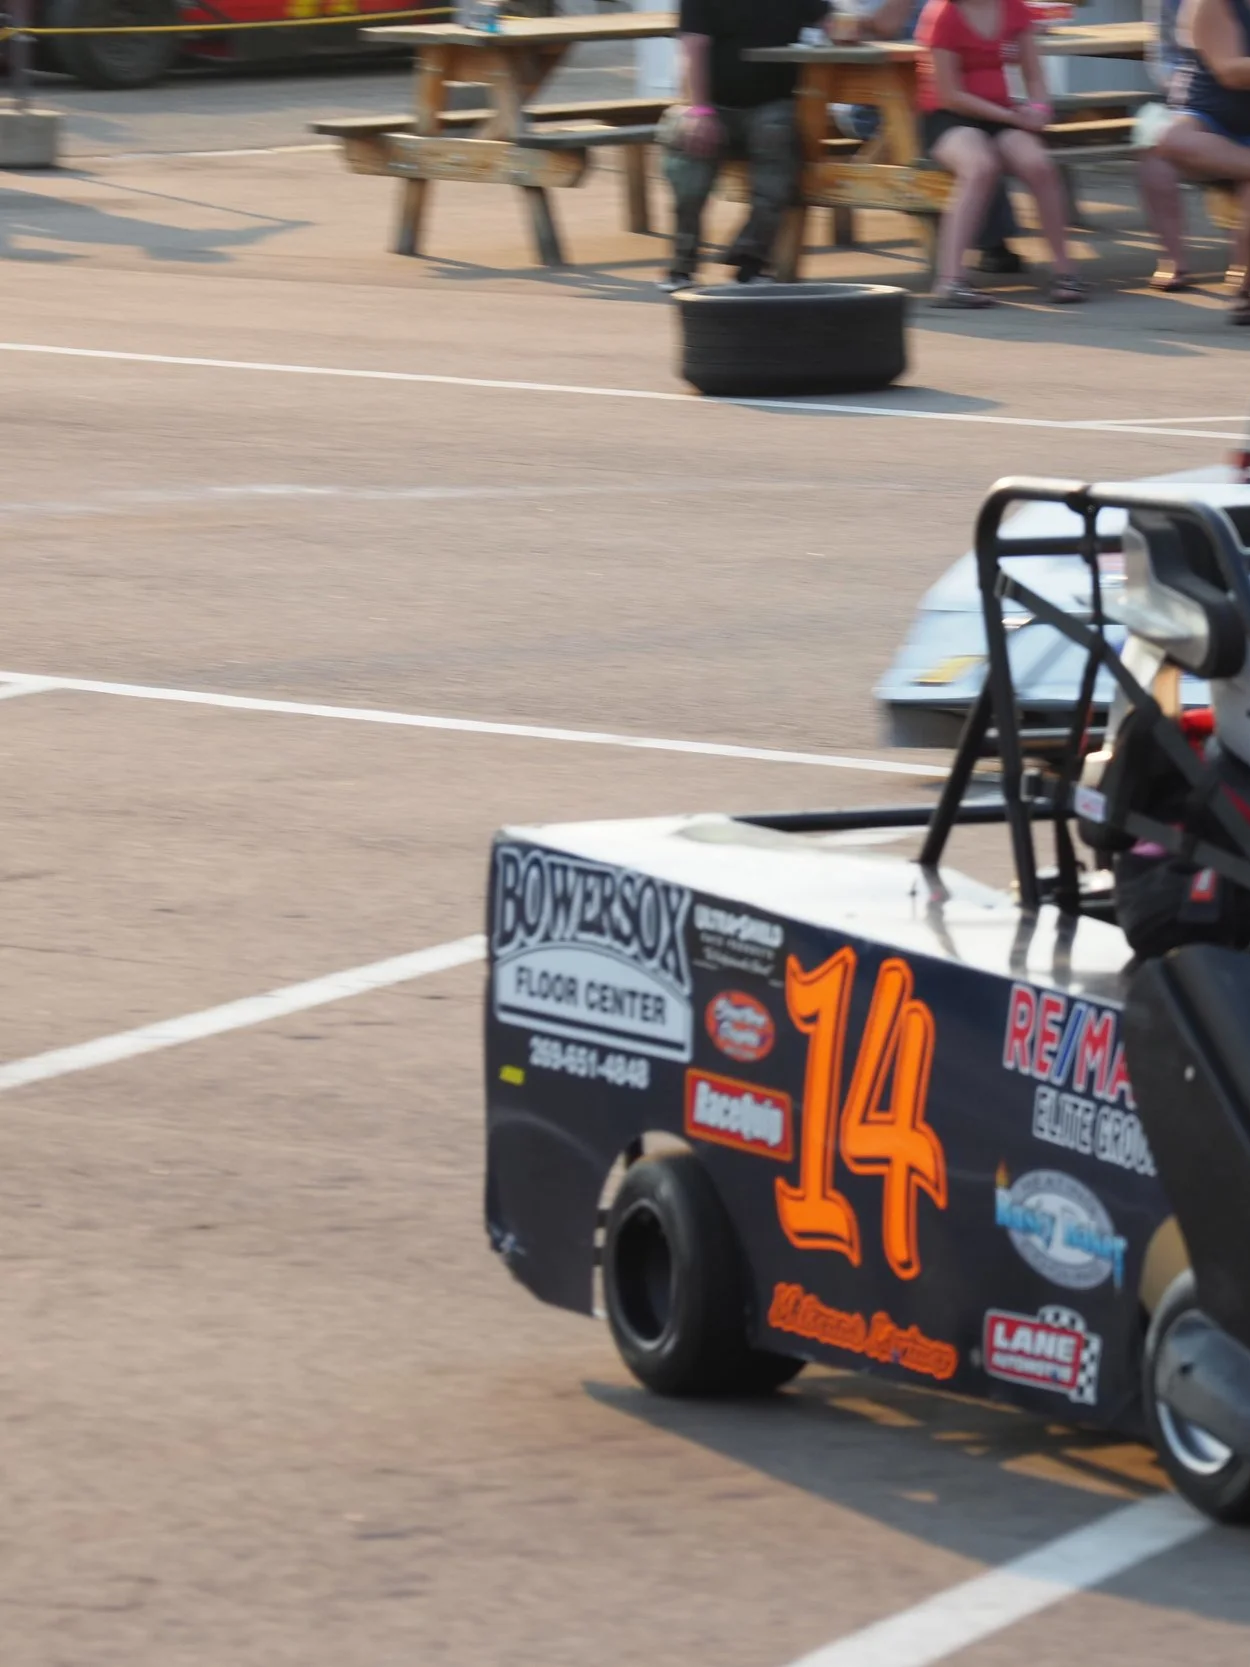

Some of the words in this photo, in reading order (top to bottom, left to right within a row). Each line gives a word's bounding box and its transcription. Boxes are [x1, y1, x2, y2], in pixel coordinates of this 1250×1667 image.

[495, 848, 691, 993] BOWERSOX
[515, 967, 579, 1006] FLOOR
[584, 980, 667, 1026] CENTER
[1002, 983, 1138, 1111] RE/MA
[776, 945, 947, 1280] 14
[1032, 1084, 1097, 1156] ELITE
[1094, 1105, 1158, 1178] GROU
[993, 1321, 1078, 1364] LANE
